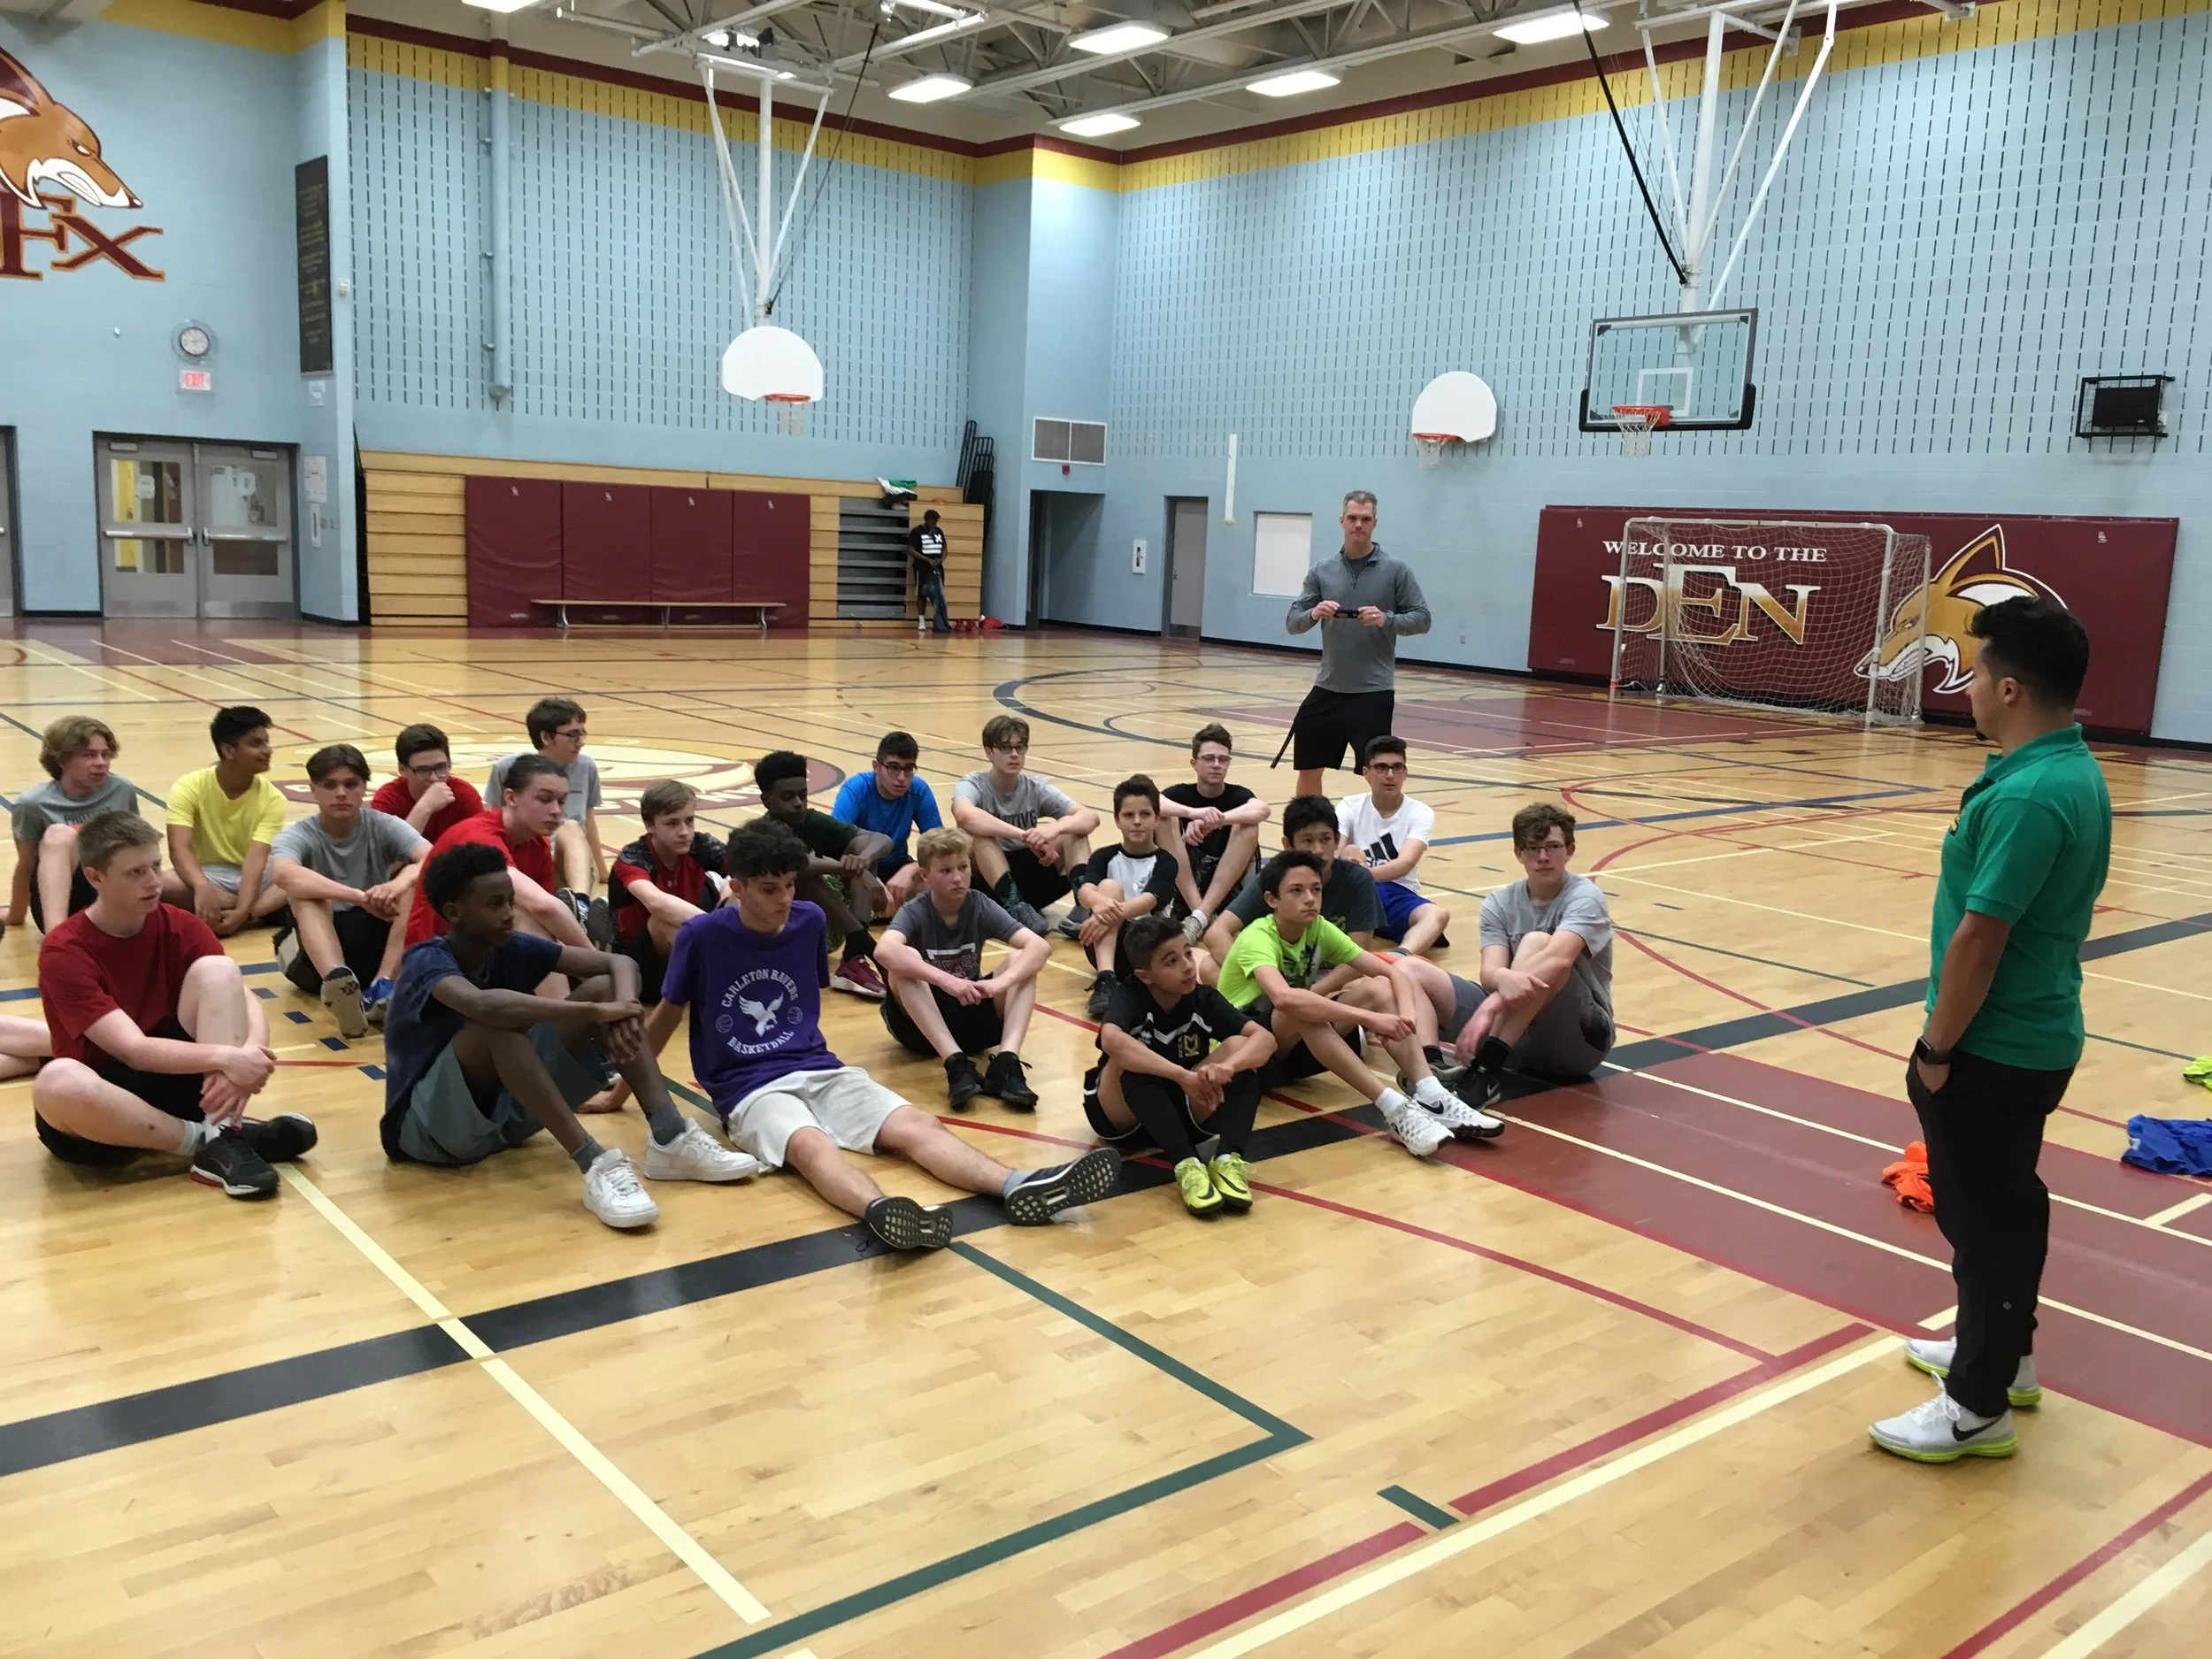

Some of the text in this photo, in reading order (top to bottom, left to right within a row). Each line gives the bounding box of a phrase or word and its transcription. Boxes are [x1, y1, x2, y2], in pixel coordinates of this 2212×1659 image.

[1602, 541, 1828, 563] WELCOME TO THE
[1595, 563, 1822, 646] DEN
[721, 969, 799, 1008] CARLETON RAVENS
[727, 1031, 795, 1055] BASKETBALL
